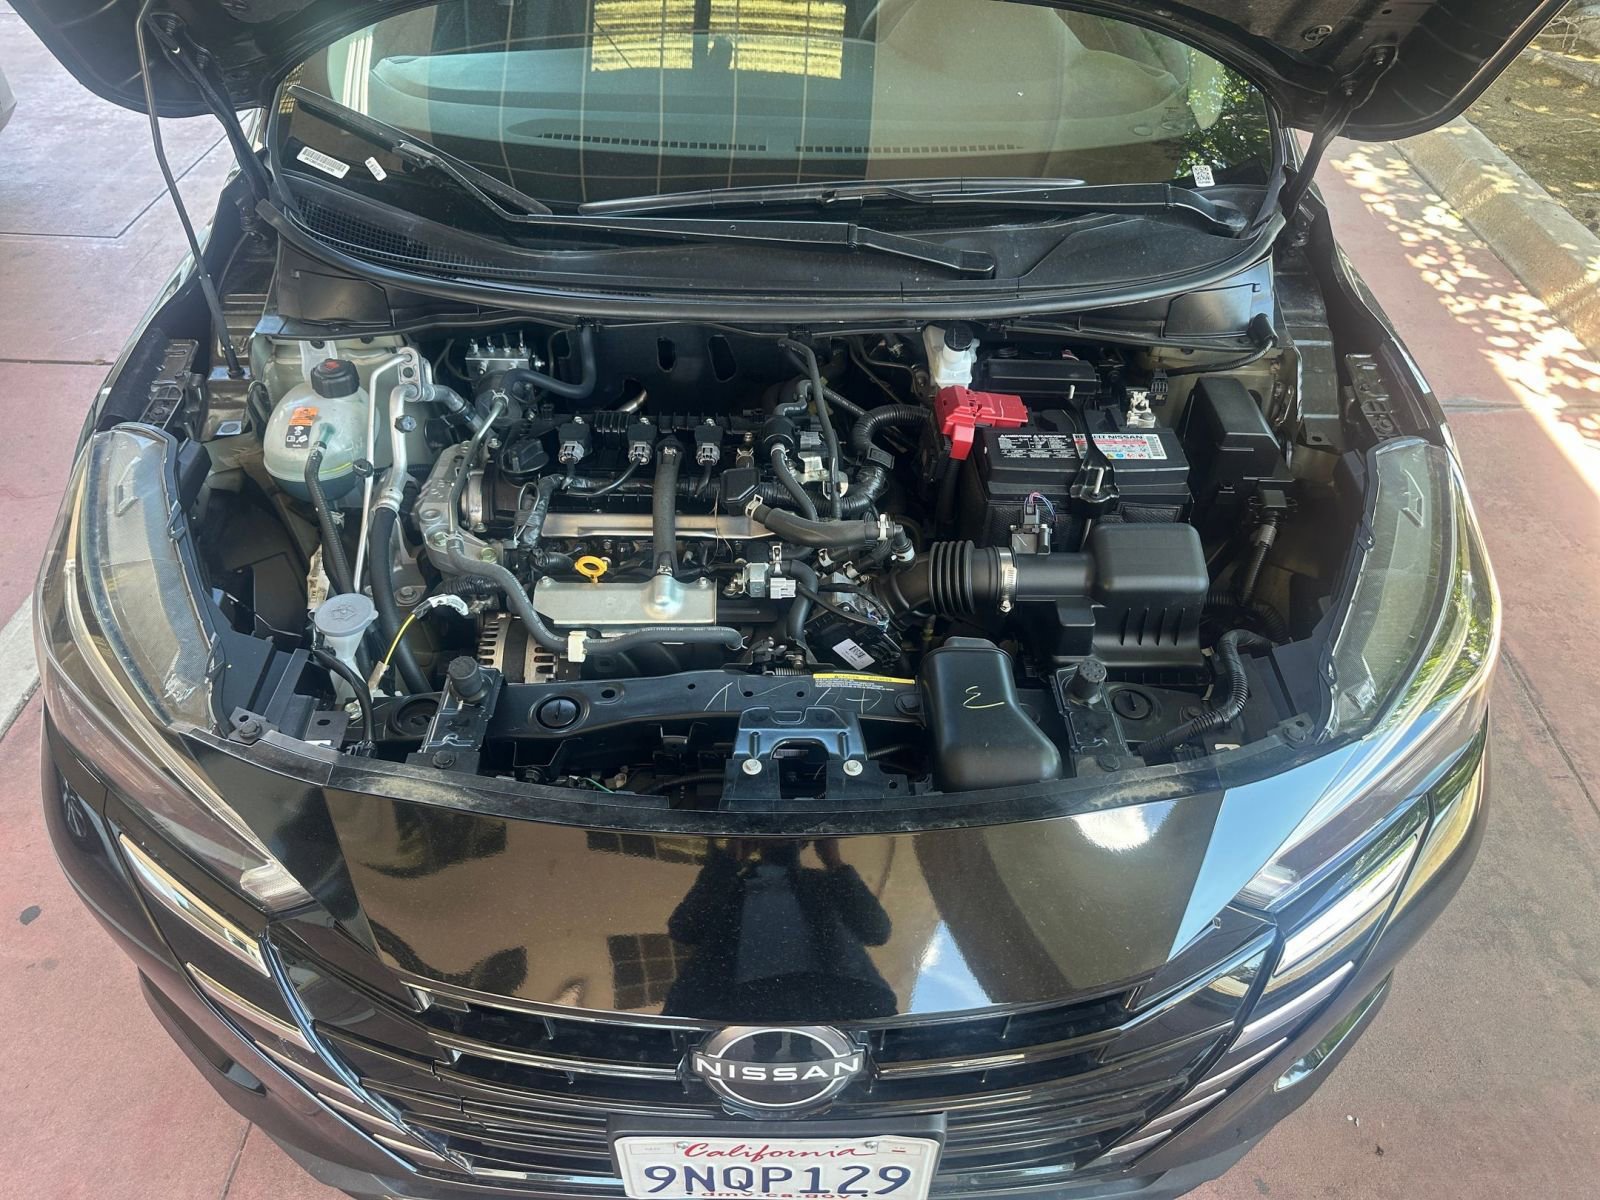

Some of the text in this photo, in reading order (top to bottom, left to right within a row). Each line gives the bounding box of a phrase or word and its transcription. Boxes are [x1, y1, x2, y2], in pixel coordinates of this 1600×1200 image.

[696, 1057, 859, 1082] NISSAN
[683, 1142, 877, 1163] California
[644, 1165, 912, 1195] 9NQP129
